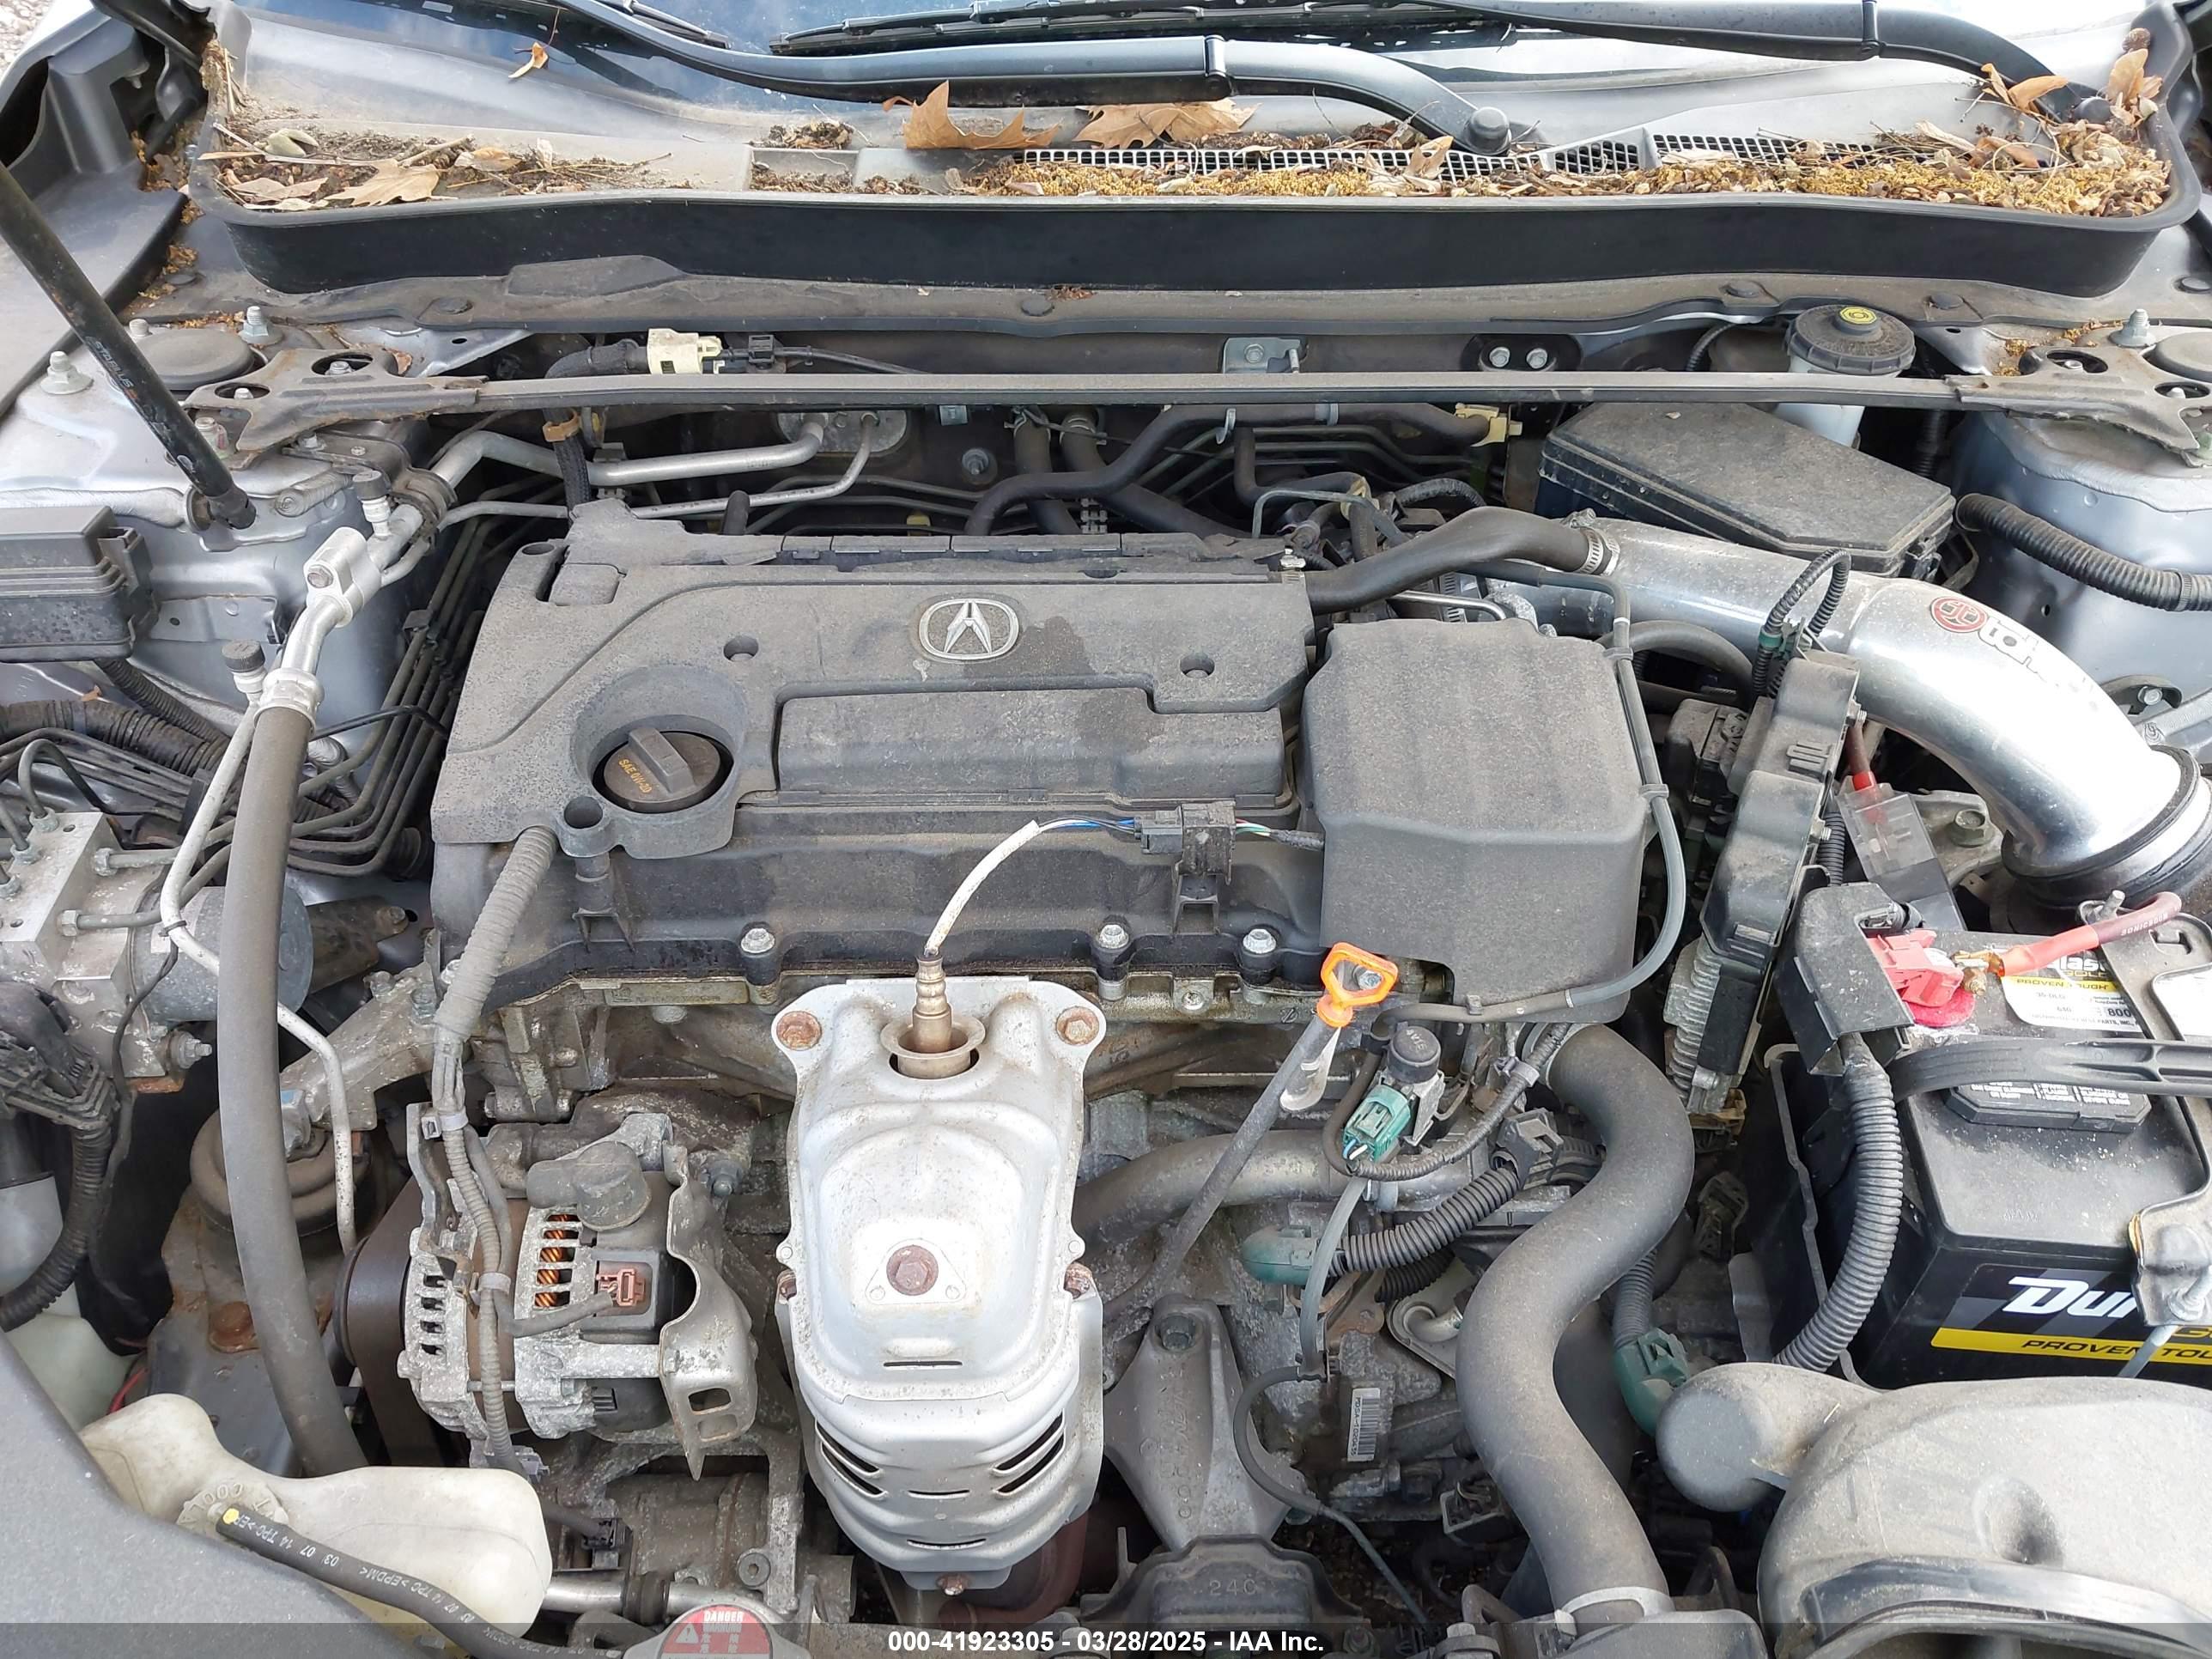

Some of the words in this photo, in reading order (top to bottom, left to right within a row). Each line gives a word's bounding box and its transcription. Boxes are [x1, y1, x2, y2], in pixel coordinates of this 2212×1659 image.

[618, 758, 637, 775] SAE
[630, 771, 653, 793] 0W-20
[2016, 977, 2064, 988] PROVEN
[2107, 1007, 2131, 1018] 800
[255, 1524, 279, 1544] TPC
[279, 1535, 294, 1550] 14
[299, 1545, 317, 1558] 07
[324, 1553, 340, 1567] 03
[703, 1610, 744, 1622] DANGER
